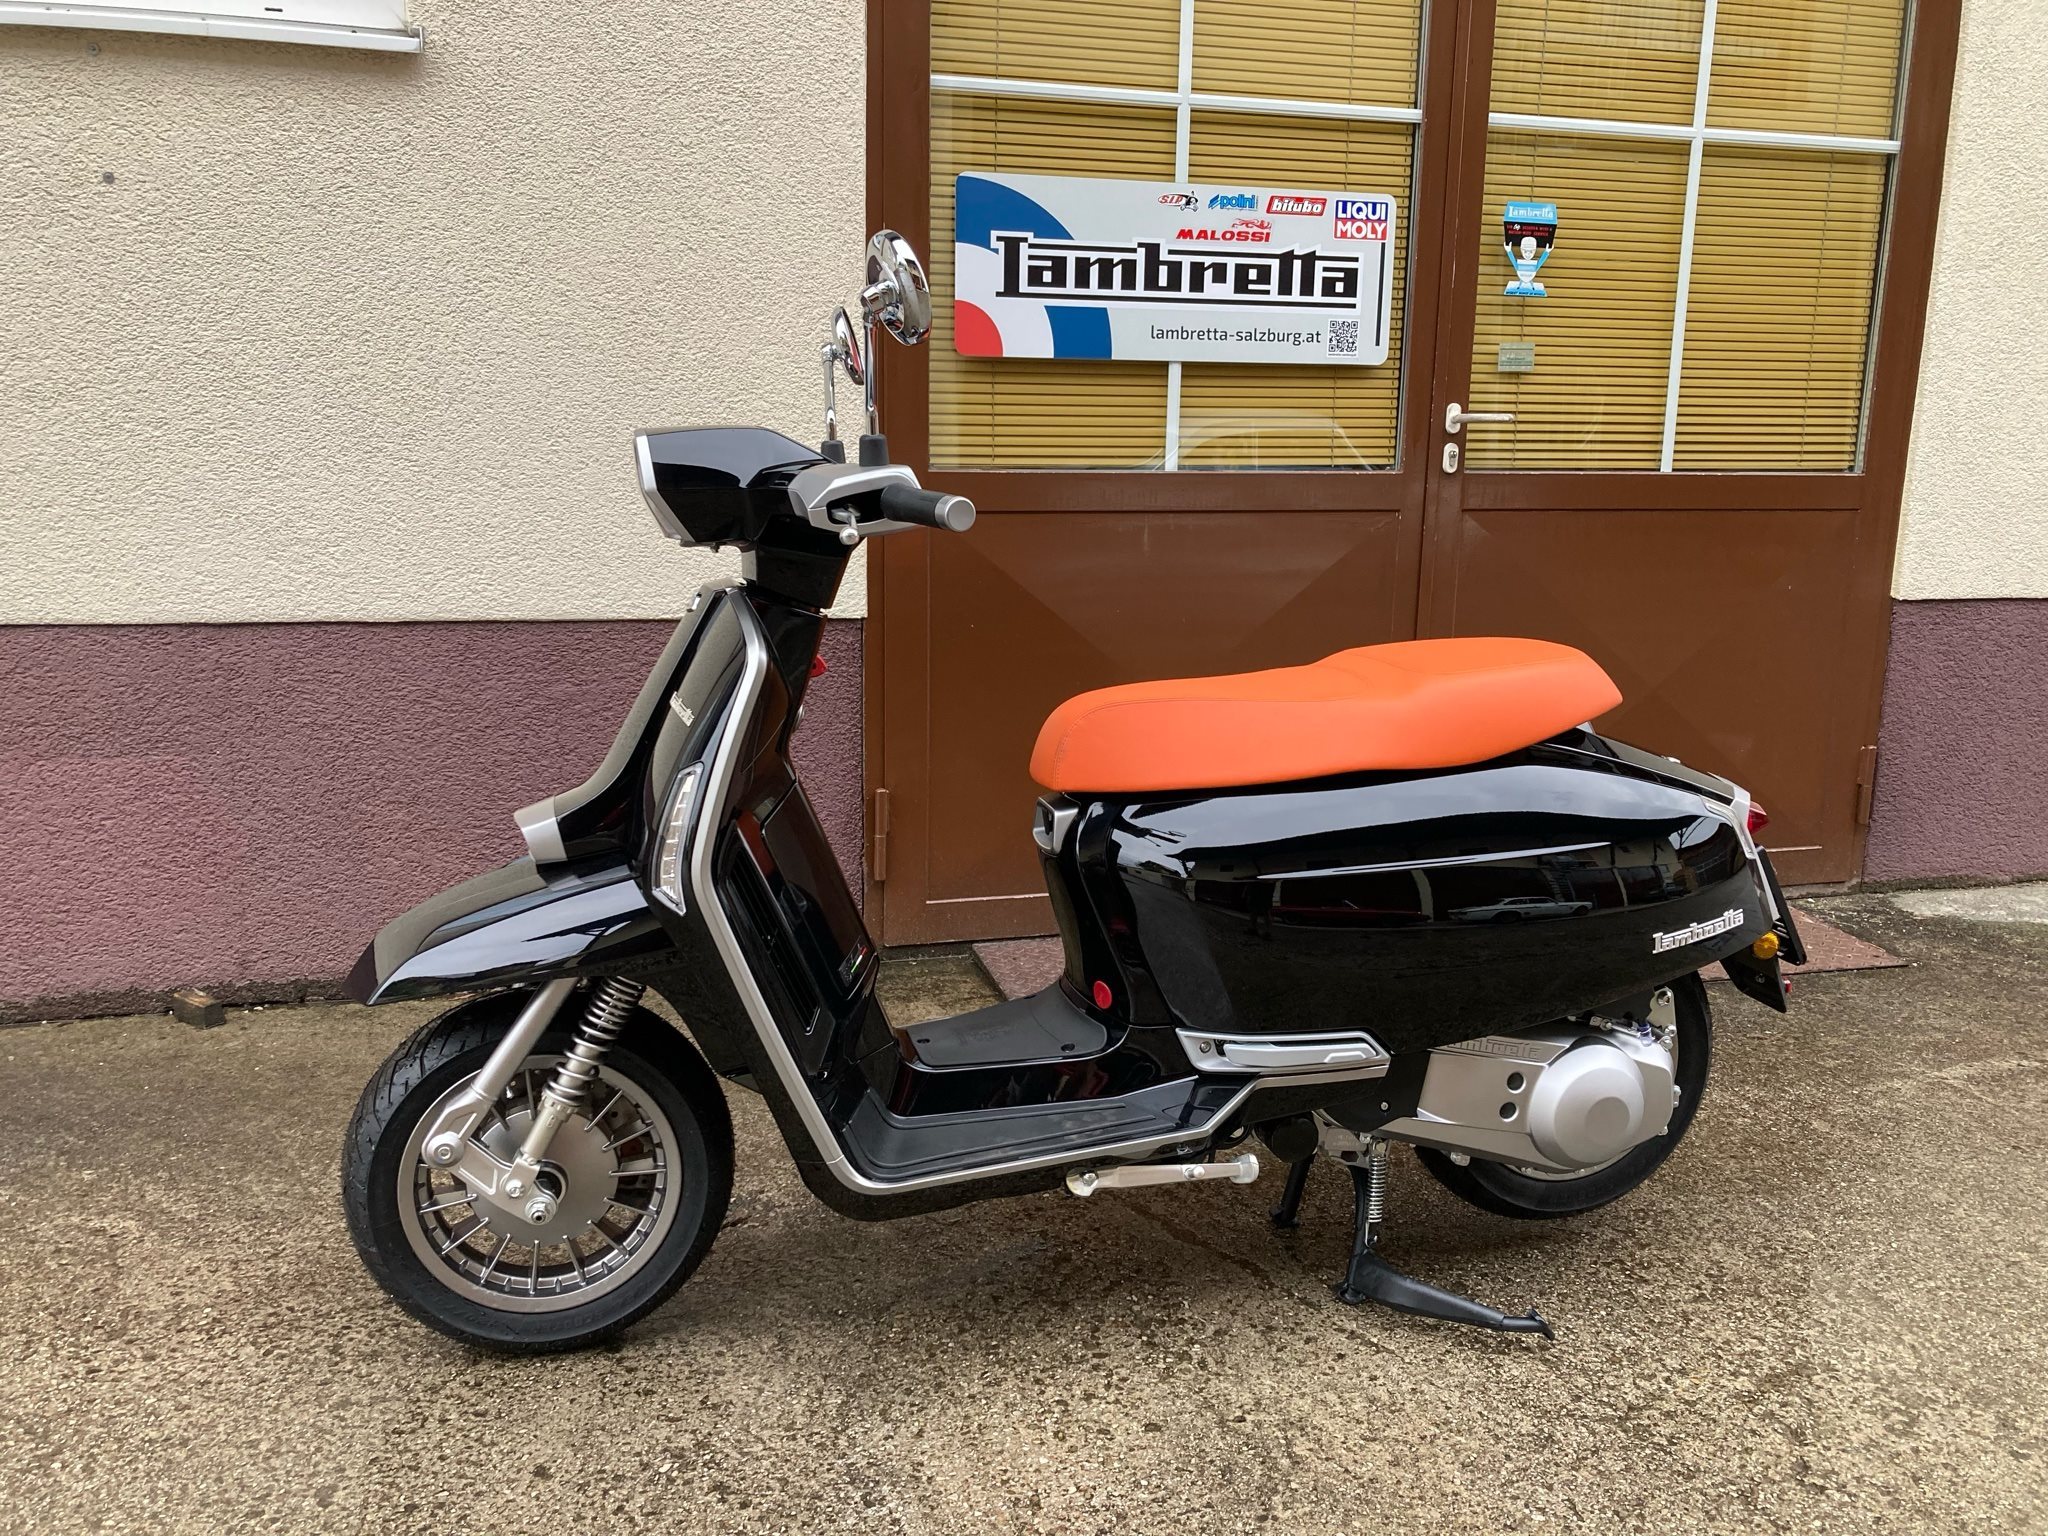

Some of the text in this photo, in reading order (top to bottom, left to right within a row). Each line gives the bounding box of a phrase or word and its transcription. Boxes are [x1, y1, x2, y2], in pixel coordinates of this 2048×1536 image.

[1219, 193, 1256, 209] polini
[1271, 198, 1323, 213] bitubo
[1337, 201, 1386, 220] LIQUI
[1175, 228, 1272, 243] MALOSSI
[1336, 220, 1387, 239] MOLY
[995, 235, 1360, 309] Lambretta
[1150, 324, 1322, 347] lambretta-salzburg.at
[1652, 908, 1744, 954] Lambretta
